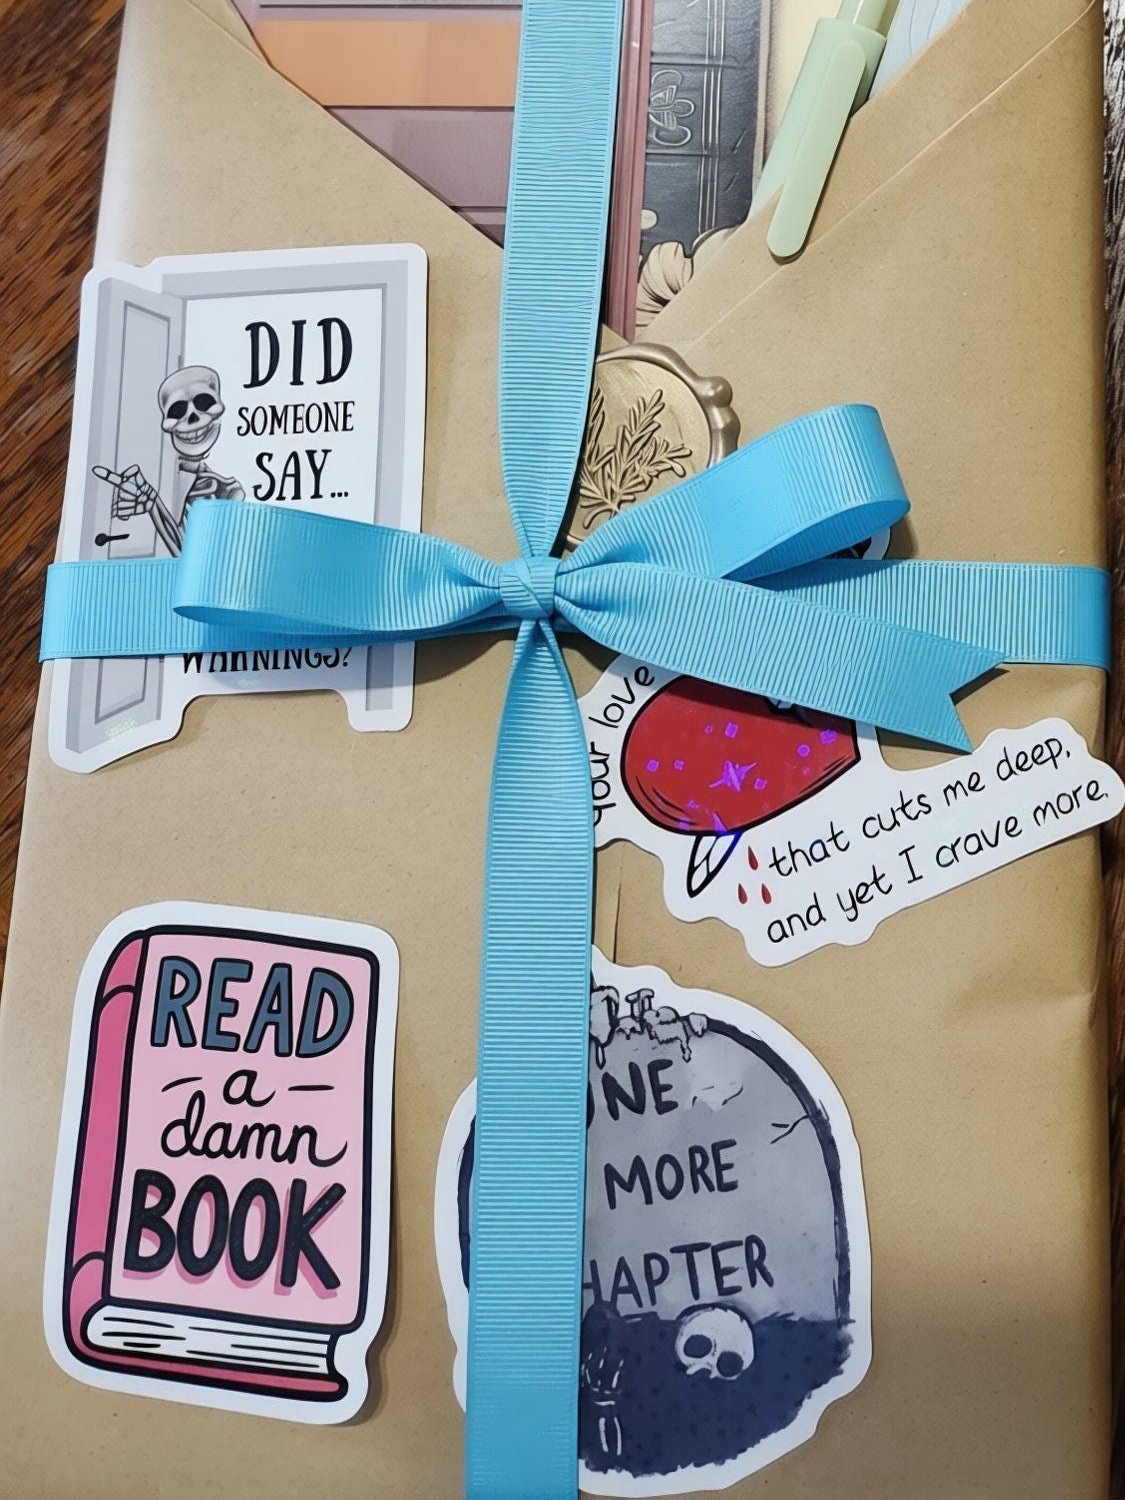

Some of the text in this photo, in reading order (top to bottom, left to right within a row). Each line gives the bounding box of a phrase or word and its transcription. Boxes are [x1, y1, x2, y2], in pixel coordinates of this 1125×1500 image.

[243, 316, 354, 389] DID
[236, 401, 355, 437] SOMEONE
[253, 448, 349, 501] SAY...
[588, 665, 655, 728] love
[767, 779, 1109, 943] and yet I crave more.
[769, 820, 850, 878] that
[862, 788, 932, 839] cuts
[941, 773, 986, 809] me
[150, 955, 355, 1059] READ
[222, 1068, 276, 1107] a
[587, 1059, 679, 1130] NE
[161, 1089, 348, 1167] damn
[603, 1139, 739, 1210] MORE
[123, 1168, 347, 1294] BOOK
[582, 1234, 775, 1308] HAPTER
